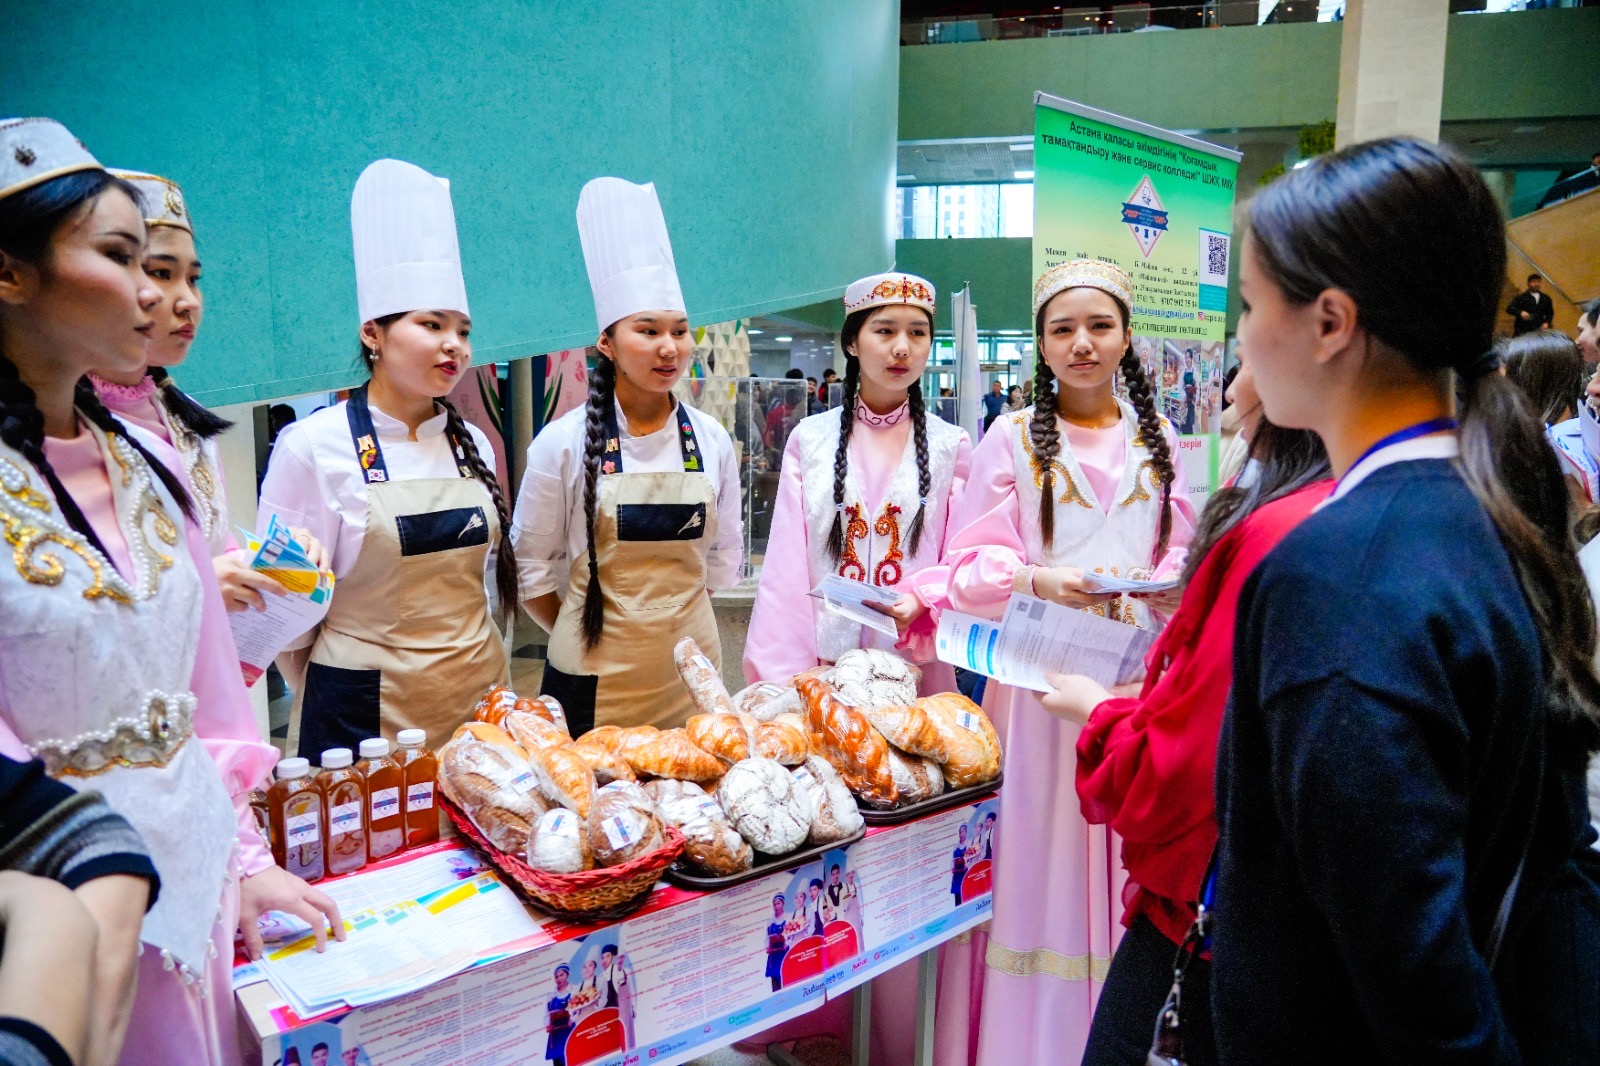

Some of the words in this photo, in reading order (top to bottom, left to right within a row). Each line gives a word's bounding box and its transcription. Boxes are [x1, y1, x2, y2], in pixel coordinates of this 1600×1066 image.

[1070, 121, 1101, 139] Астана
[1104, 132, 1134, 149] қаласы
[1042, 134, 1110, 160] тамақтандыру
[1112, 151, 1132, 164] және
[1134, 157, 1162, 173] сервис
